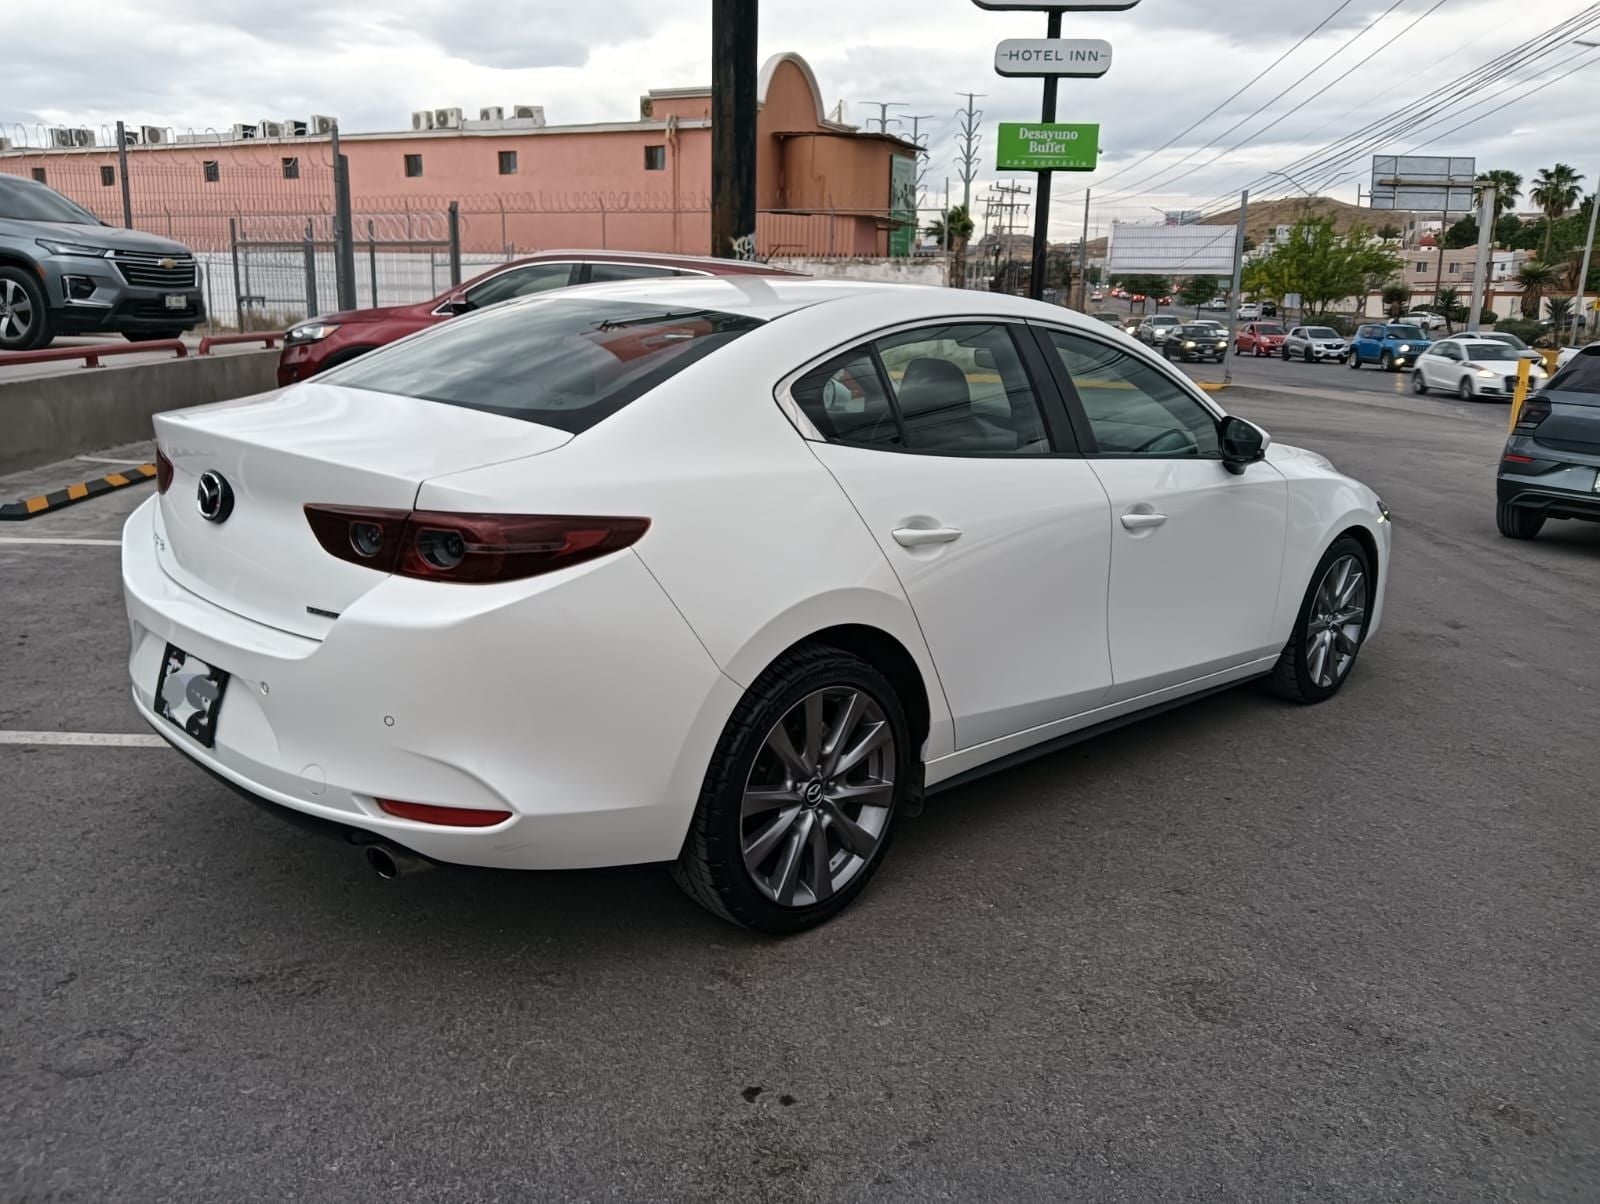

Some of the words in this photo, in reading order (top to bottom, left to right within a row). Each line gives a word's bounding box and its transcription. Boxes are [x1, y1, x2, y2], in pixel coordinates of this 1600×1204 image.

[1008, 49, 1064, 61] HOTEL
[1070, 50, 1099, 62] INN
[1019, 127, 1078, 141] Desayuno
[1029, 141, 1066, 153] Buffet
